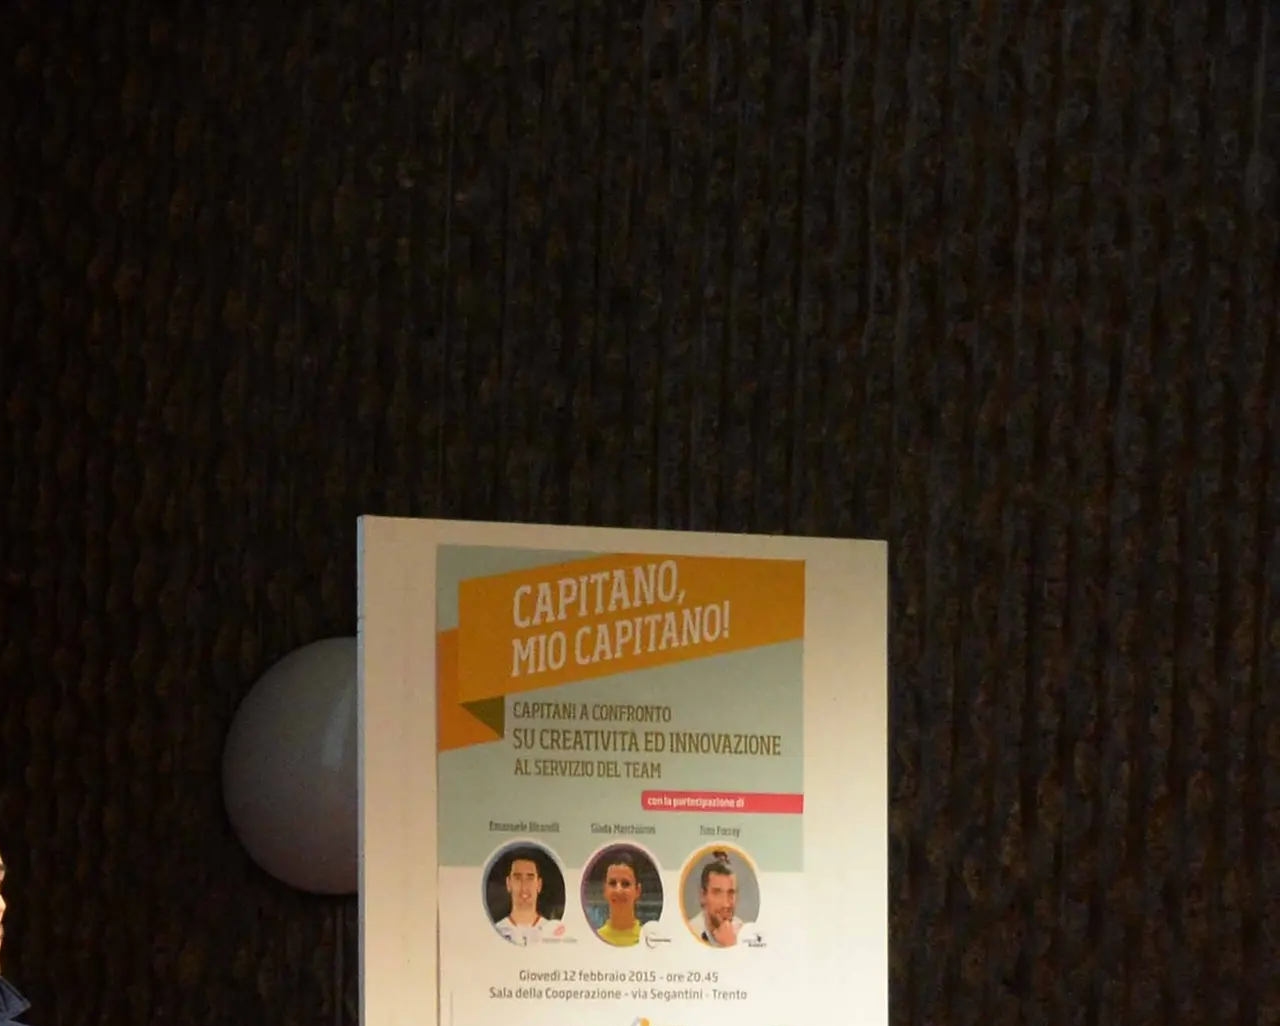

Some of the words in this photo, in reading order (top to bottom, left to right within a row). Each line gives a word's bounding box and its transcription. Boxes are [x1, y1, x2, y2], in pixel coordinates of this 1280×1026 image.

[513, 559, 686, 628] CAPITANO,
[510, 631, 567, 677] MIO
[574, 600, 730, 665] CAPITANO!
[580, 704, 589, 720] A
[592, 704, 672, 723] CONFRONTO
[513, 728, 535, 750] SU
[644, 732, 665, 752] ED
[670, 733, 781, 756] INNOVAZIONE
[514, 760, 531, 776] AL
[535, 760, 594, 777] SERVIZIO
[597, 761, 621, 778] DEL
[624, 762, 661, 779] TEAM
[562, 970, 577, 982] 12
[578, 970, 627, 982] febbraio
[628, 971, 656, 983] 2015
[666, 973, 684, 983] ore
[686, 971, 719, 983] 20.45
[489, 987, 512, 1000] Sala
[515, 988, 543, 1000] della
[545, 988, 622, 1002] Cooperazione
[631, 988, 648, 1000] via
[650, 988, 703, 1002] Segantini
[712, 989, 748, 1000] Trento
